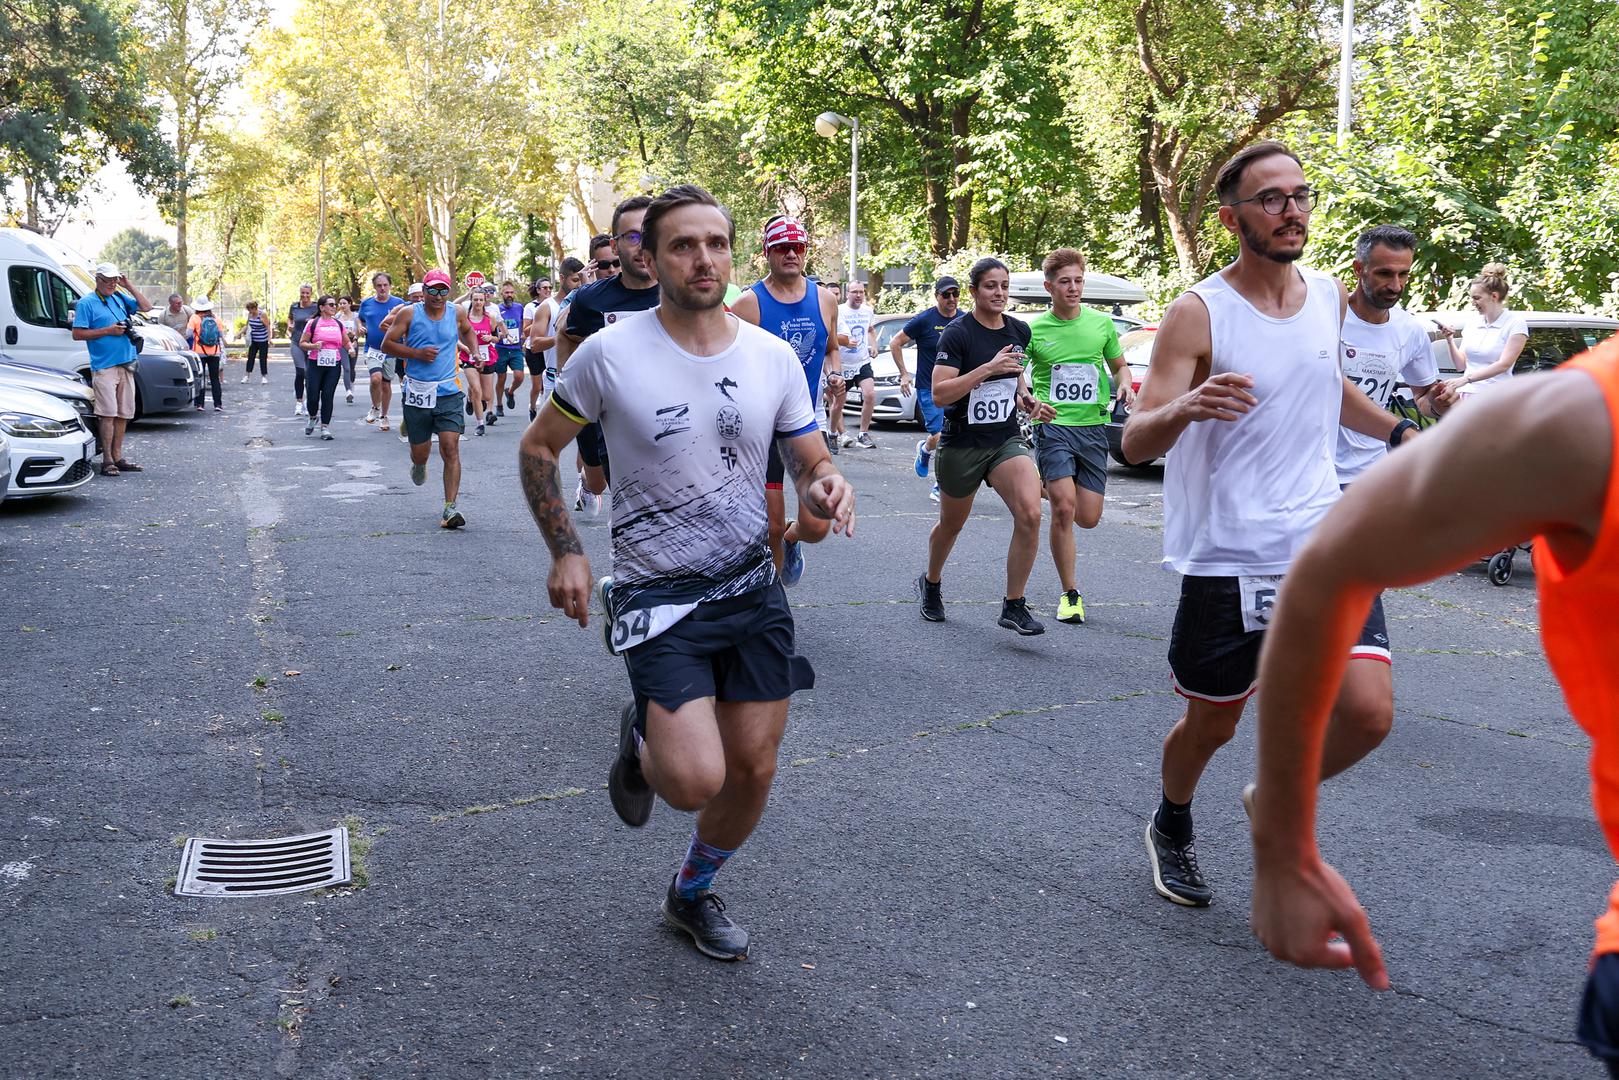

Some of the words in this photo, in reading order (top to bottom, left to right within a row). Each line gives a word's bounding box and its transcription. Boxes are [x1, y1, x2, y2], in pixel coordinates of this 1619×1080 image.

[779, 230, 802, 238] CROATIA
[467, 276, 484, 286] STOP
[319, 356, 335, 365] 504
[1055, 382, 1092, 401] 696
[409, 392, 431, 407] 551
[974, 398, 1009, 421] 697
[1255, 589, 1276, 625] 5
